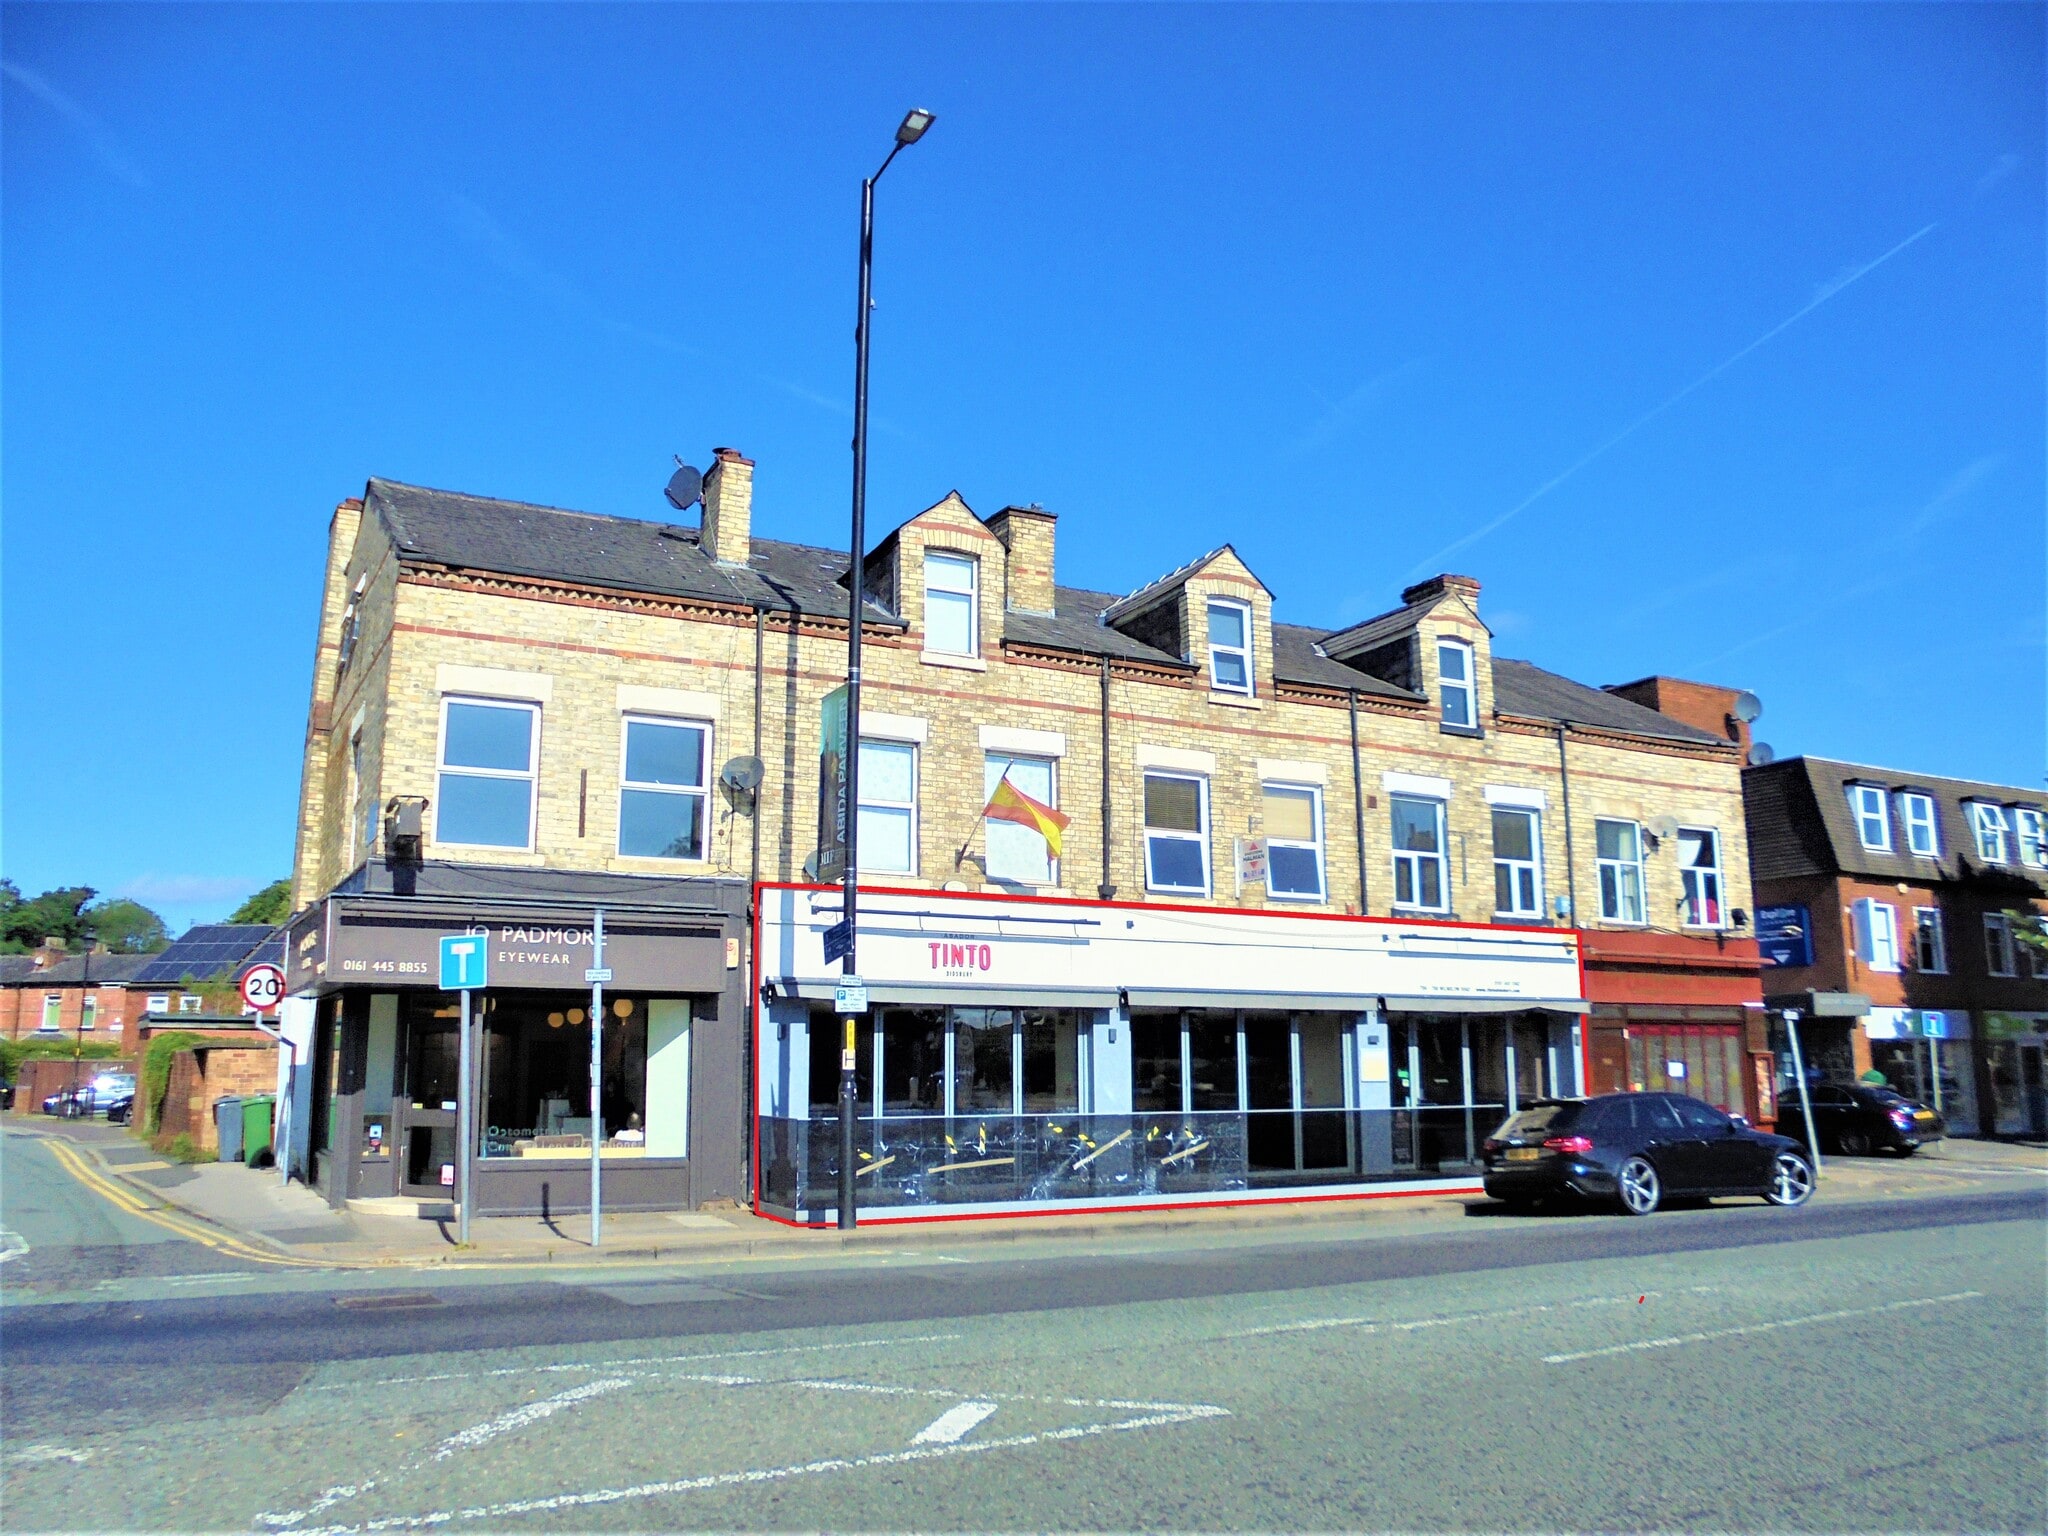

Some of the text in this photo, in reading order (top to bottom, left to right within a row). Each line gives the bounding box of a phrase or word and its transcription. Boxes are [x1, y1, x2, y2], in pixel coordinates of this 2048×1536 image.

[837, 697, 848, 783] PARVEEN
[836, 786, 846, 843] ABIDA
[343, 960, 428, 973] 0161 445 8855
[499, 951, 570, 964] EYEWEAR
[928, 942, 991, 971] TINTO
[250, 978, 279, 996] 20
